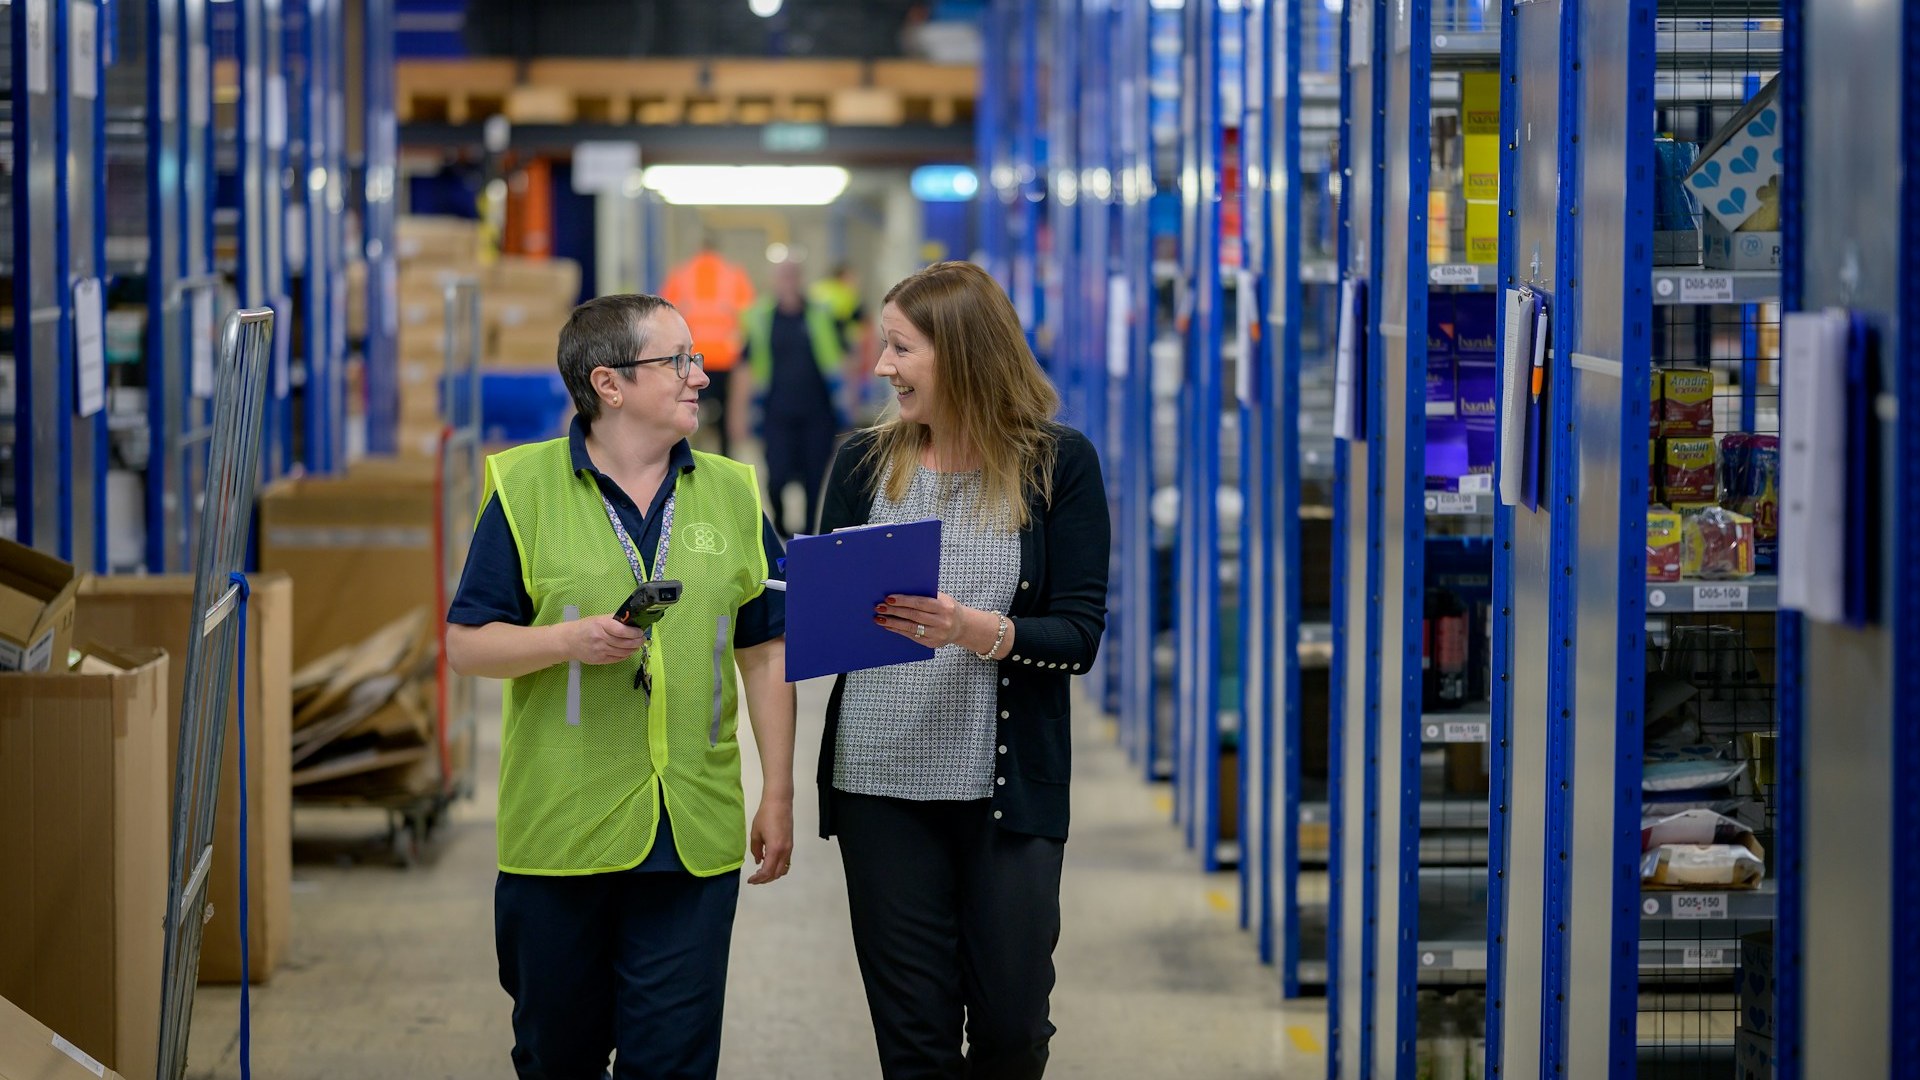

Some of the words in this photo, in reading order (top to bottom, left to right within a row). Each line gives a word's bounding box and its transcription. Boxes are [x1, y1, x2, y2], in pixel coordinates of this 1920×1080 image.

[1746, 239, 1758, 250] 70
[1685, 278, 1727, 289] D05-050
[1671, 376, 1708, 385] Anadin
[1673, 442, 1709, 451] Anadin
[1700, 588, 1740, 598] D05-100
[1450, 724, 1479, 733] E05-150
[1678, 897, 1719, 907] D05-150
